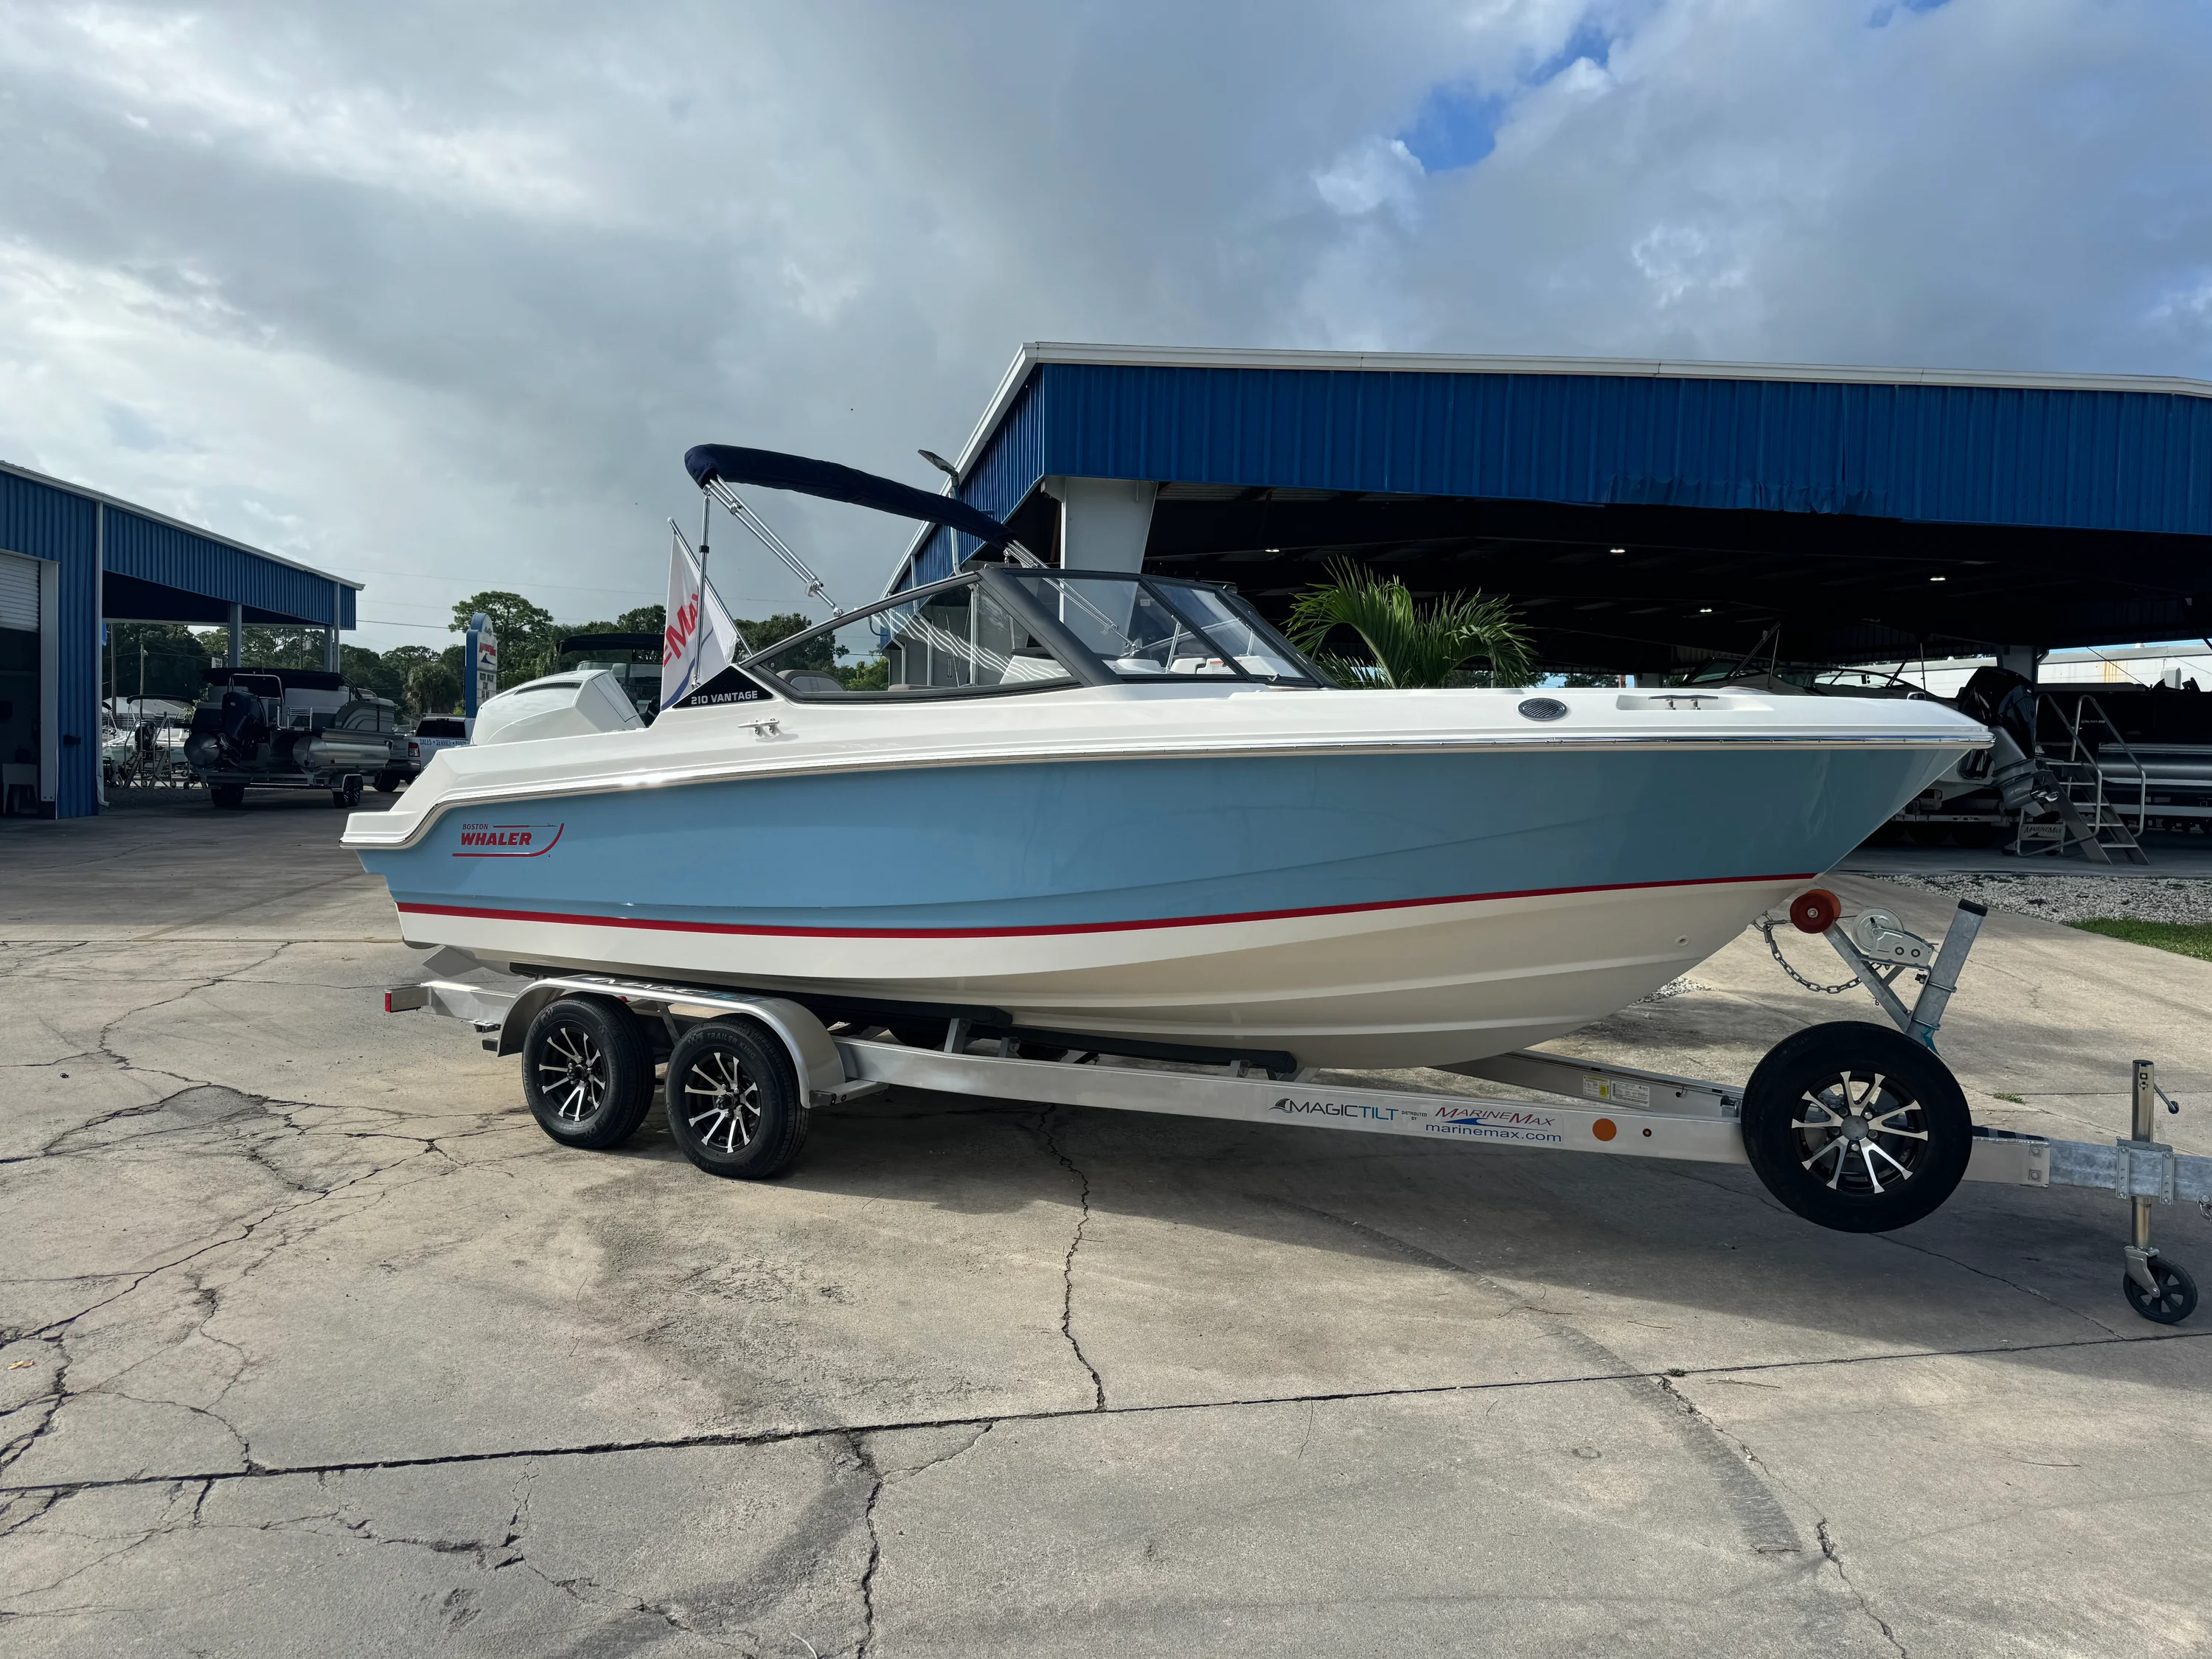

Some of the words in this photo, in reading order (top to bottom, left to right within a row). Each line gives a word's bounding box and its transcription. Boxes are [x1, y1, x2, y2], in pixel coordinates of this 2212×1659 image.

[691, 695, 708, 705] 210
[711, 690, 758, 703] VANTAGE
[436, 739, 451, 747] SERVICE
[461, 832, 532, 846] WHALER
[706, 1032, 738, 1045] TRAILER
[738, 1041, 757, 1060] KING
[1425, 1124, 1562, 1142] marinemax.com
